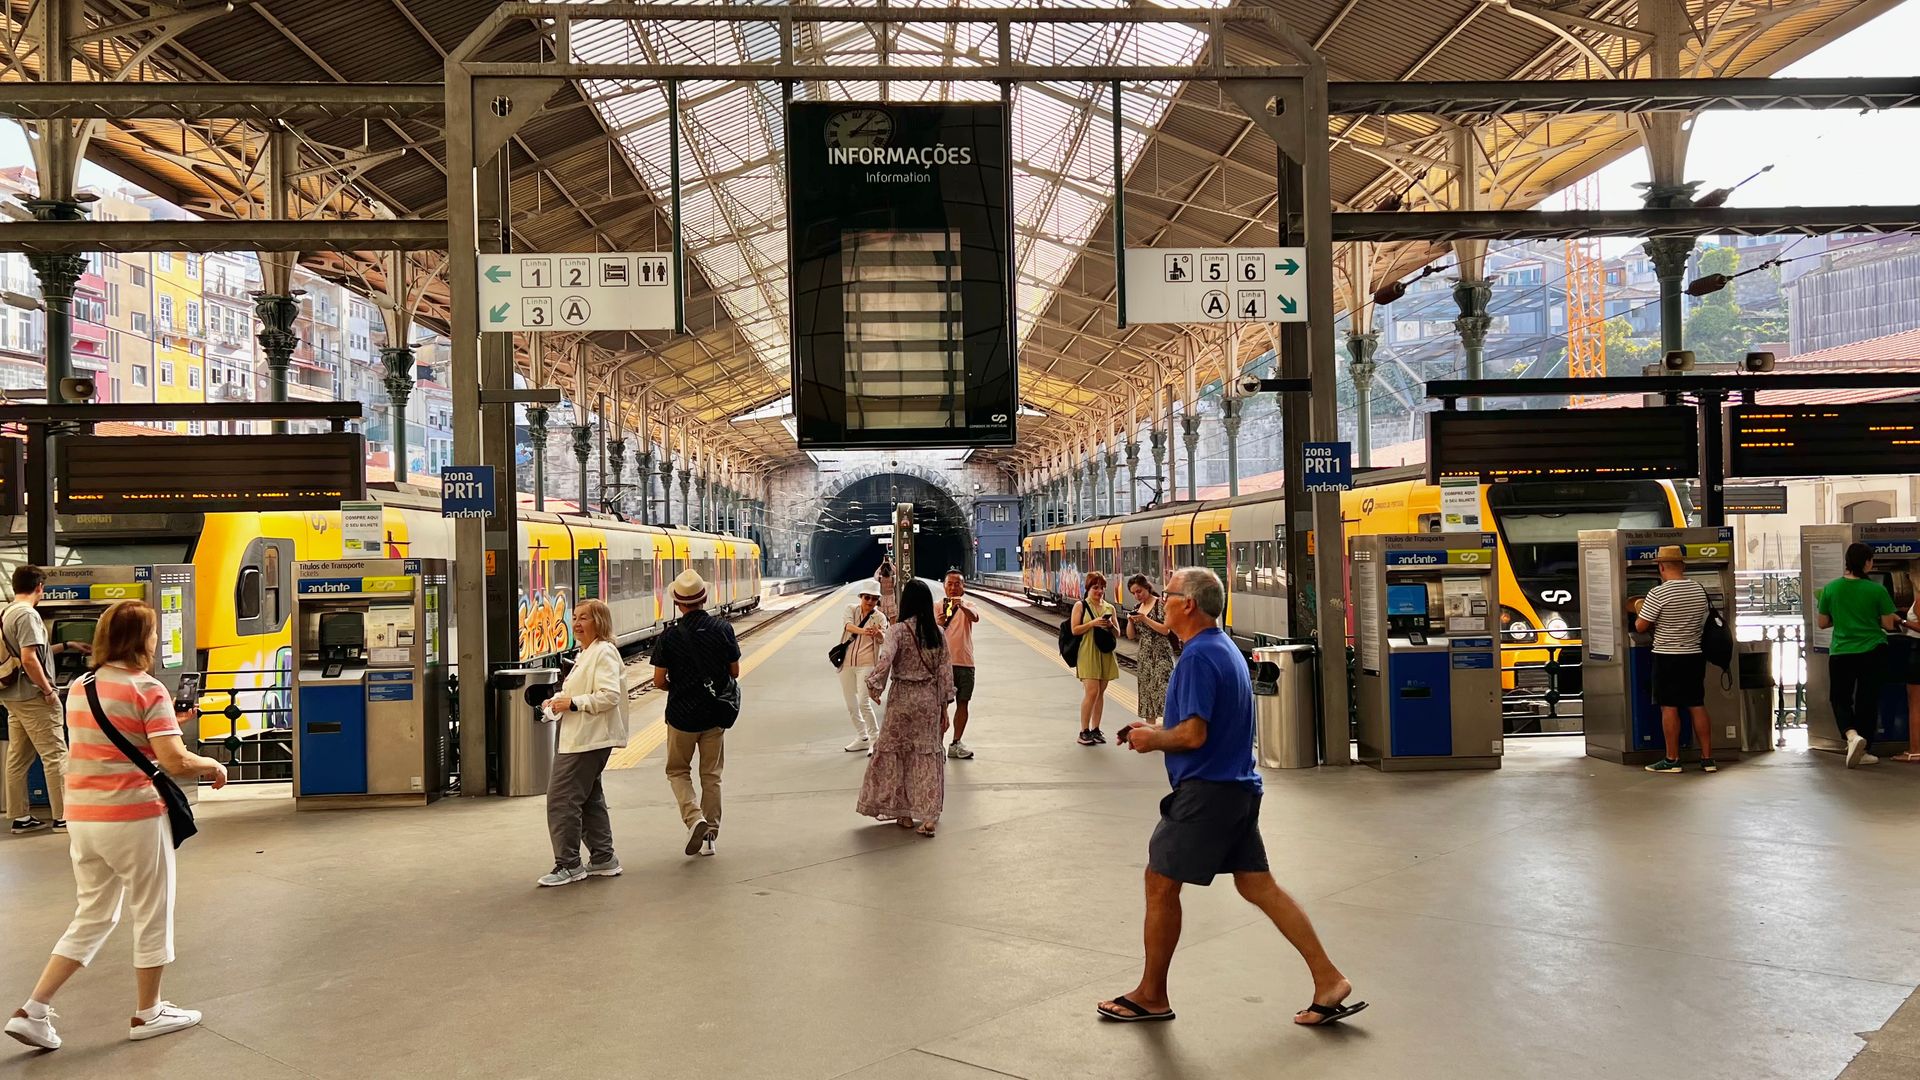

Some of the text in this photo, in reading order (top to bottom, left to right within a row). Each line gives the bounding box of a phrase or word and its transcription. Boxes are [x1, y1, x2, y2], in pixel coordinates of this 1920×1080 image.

[828, 143, 971, 169] INFORMAÇÕES
[866, 171, 931, 183] Information
[532, 268, 582, 286] 1 2
[1209, 263, 1256, 281] 5 6
[1207, 296, 1224, 314] A
[1244, 300, 1257, 316] 4
[532, 306, 545, 325] 3
[566, 302, 584, 320] A
[1305, 447, 1332, 457] zona
[1305, 458, 1341, 474] PRT1
[444, 472, 474, 482] zona
[444, 482, 483, 499] PRT1
[1306, 482, 1350, 492] andante
[445, 507, 492, 518] andante
[1460, 552, 1479, 562] CP
[1700, 547, 1718, 557] CP
[1398, 554, 1438, 564] andante
[299, 561, 365, 570] Títulos de Transporte
[59, 570, 94, 578] Transporte
[308, 582, 351, 592] andante
[42, 589, 79, 600] ndante
[104, 588, 126, 598] CP
[1540, 590, 1572, 605] CP
